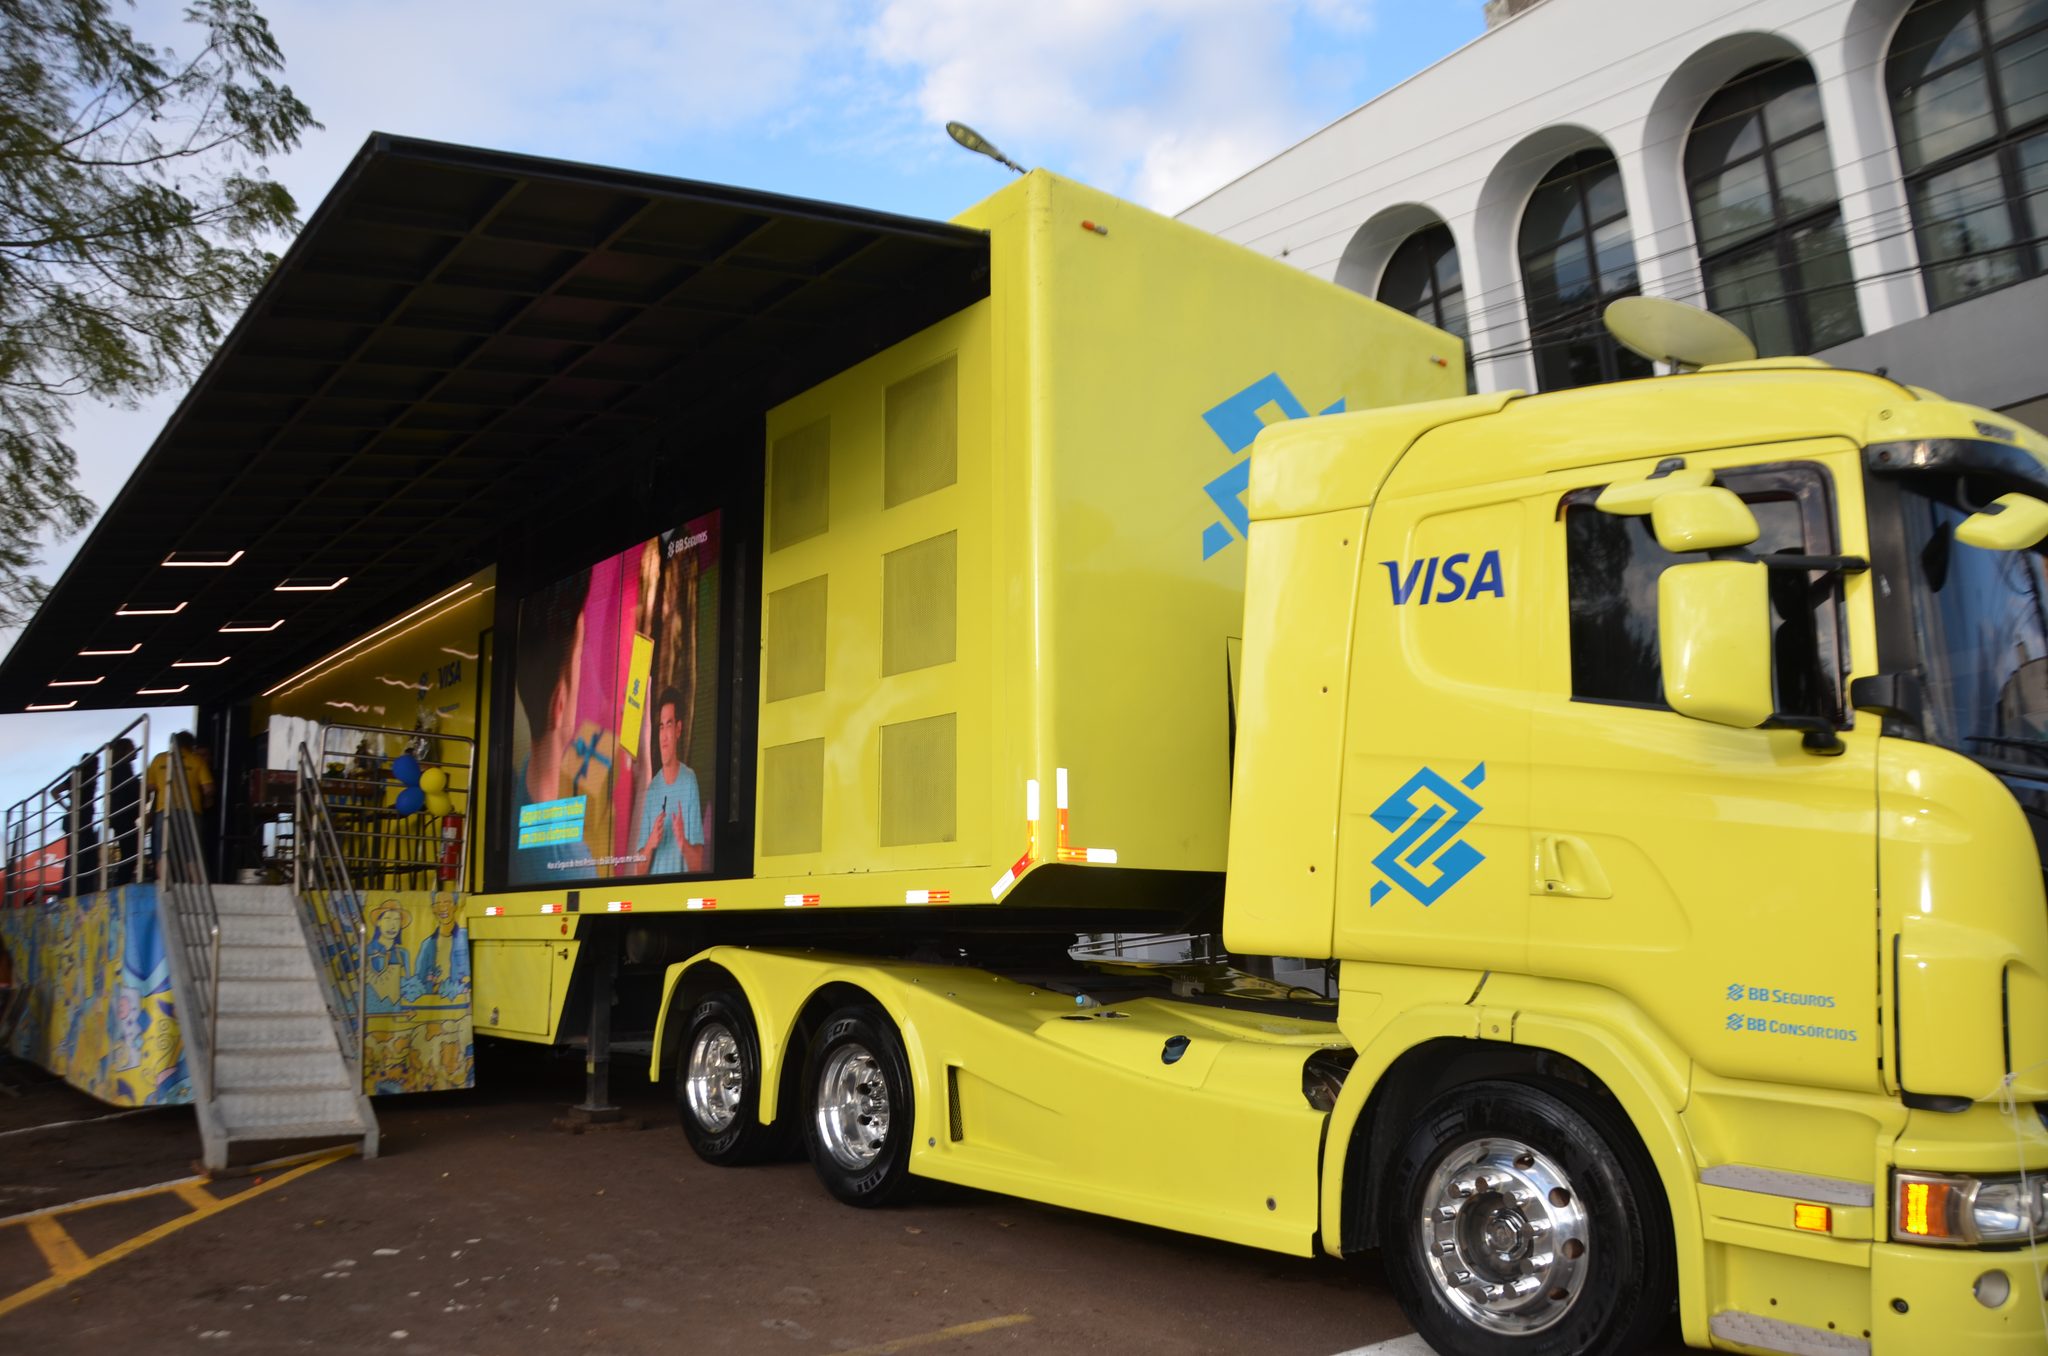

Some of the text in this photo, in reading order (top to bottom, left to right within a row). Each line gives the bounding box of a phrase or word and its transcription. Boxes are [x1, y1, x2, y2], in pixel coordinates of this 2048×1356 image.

[1377, 549, 1505, 606] VISA
[1748, 987, 1769, 1002] BB
[1747, 1017, 1767, 1032] BB
